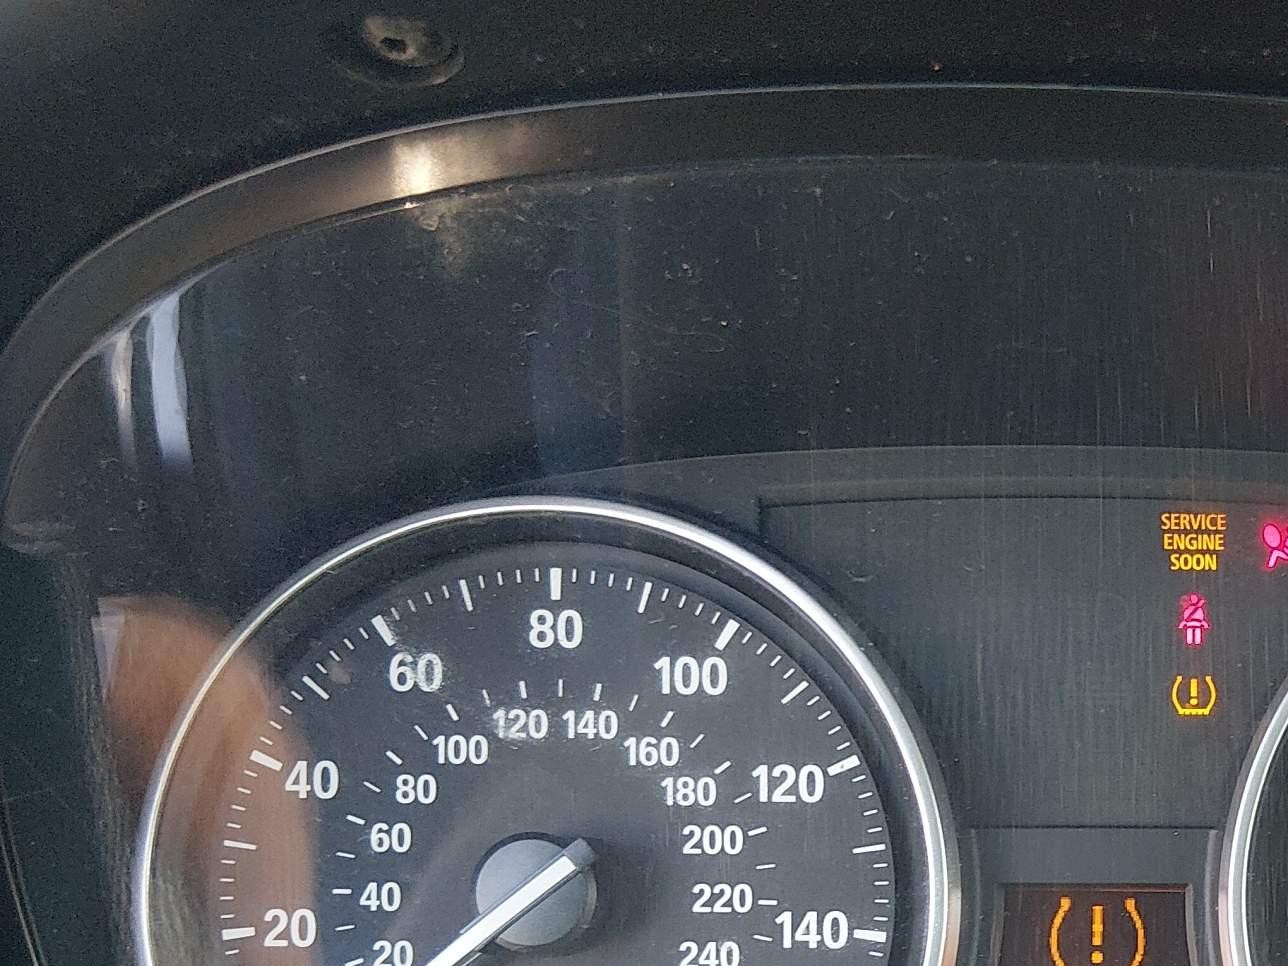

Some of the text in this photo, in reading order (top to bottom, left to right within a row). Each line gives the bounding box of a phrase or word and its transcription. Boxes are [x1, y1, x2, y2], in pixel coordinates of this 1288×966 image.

[1161, 513, 1226, 530] SERVICE
[1164, 534, 1224, 550] ENGINE
[1171, 554, 1217, 570] SOON
[529, 610, 583, 648] 80
[389, 653, 442, 692] 60
[654, 656, 727, 695] 100
[493, 709, 549, 739] 120
[562, 710, 618, 739] 140
[432, 735, 489, 765] 100
[623, 737, 680, 766] 160
[285, 760, 339, 799] 40
[395, 774, 437, 804] 80
[660, 777, 717, 806] 180
[752, 765, 824, 803] 120
[370, 823, 412, 853] 60
[682, 824, 744, 855] 200
[359, 881, 401, 912] 40
[691, 883, 753, 913] 220
[263, 908, 317, 947] 20
[774, 911, 848, 949] 140
